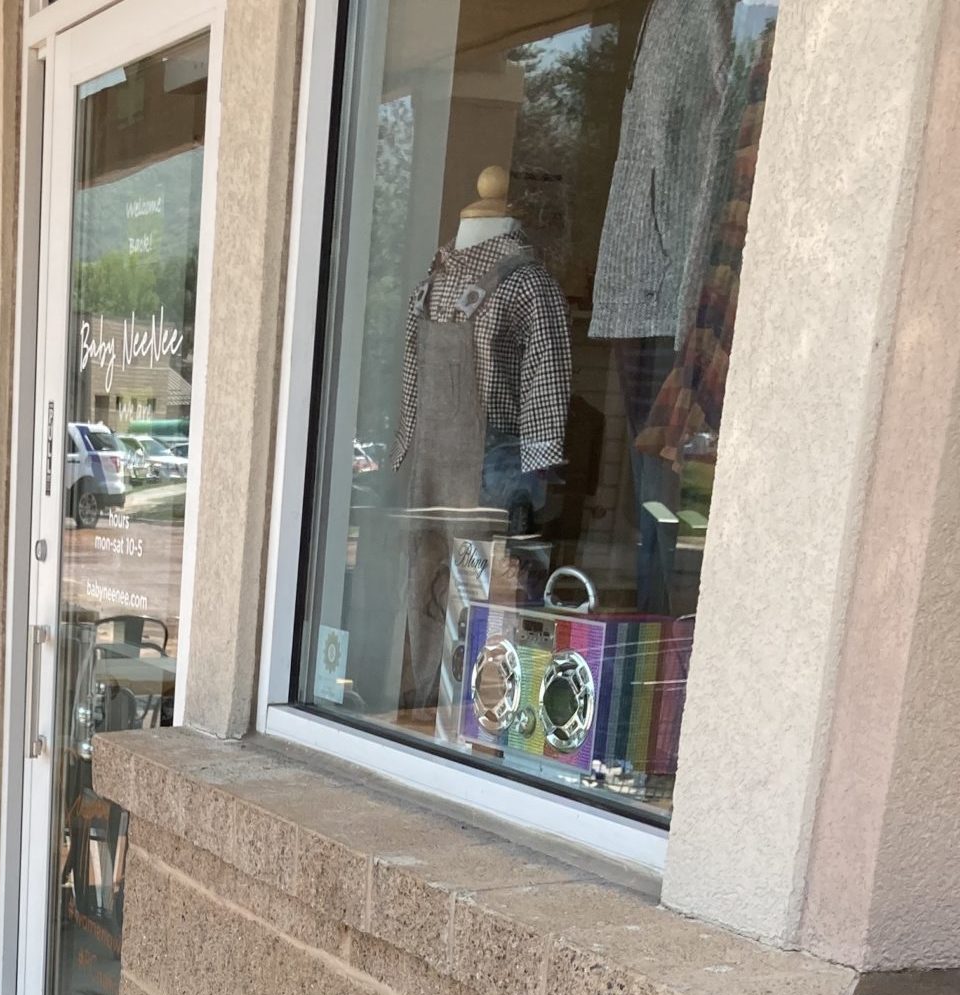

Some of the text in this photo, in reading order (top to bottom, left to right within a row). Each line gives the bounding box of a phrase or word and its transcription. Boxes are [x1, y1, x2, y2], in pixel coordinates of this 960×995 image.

[80, 305, 184, 393] Baby NeeNee
[108, 508, 130, 529] hours
[95, 536, 143, 557] mon-sat 10-5
[86, 579, 148, 610] babyneenee.com
